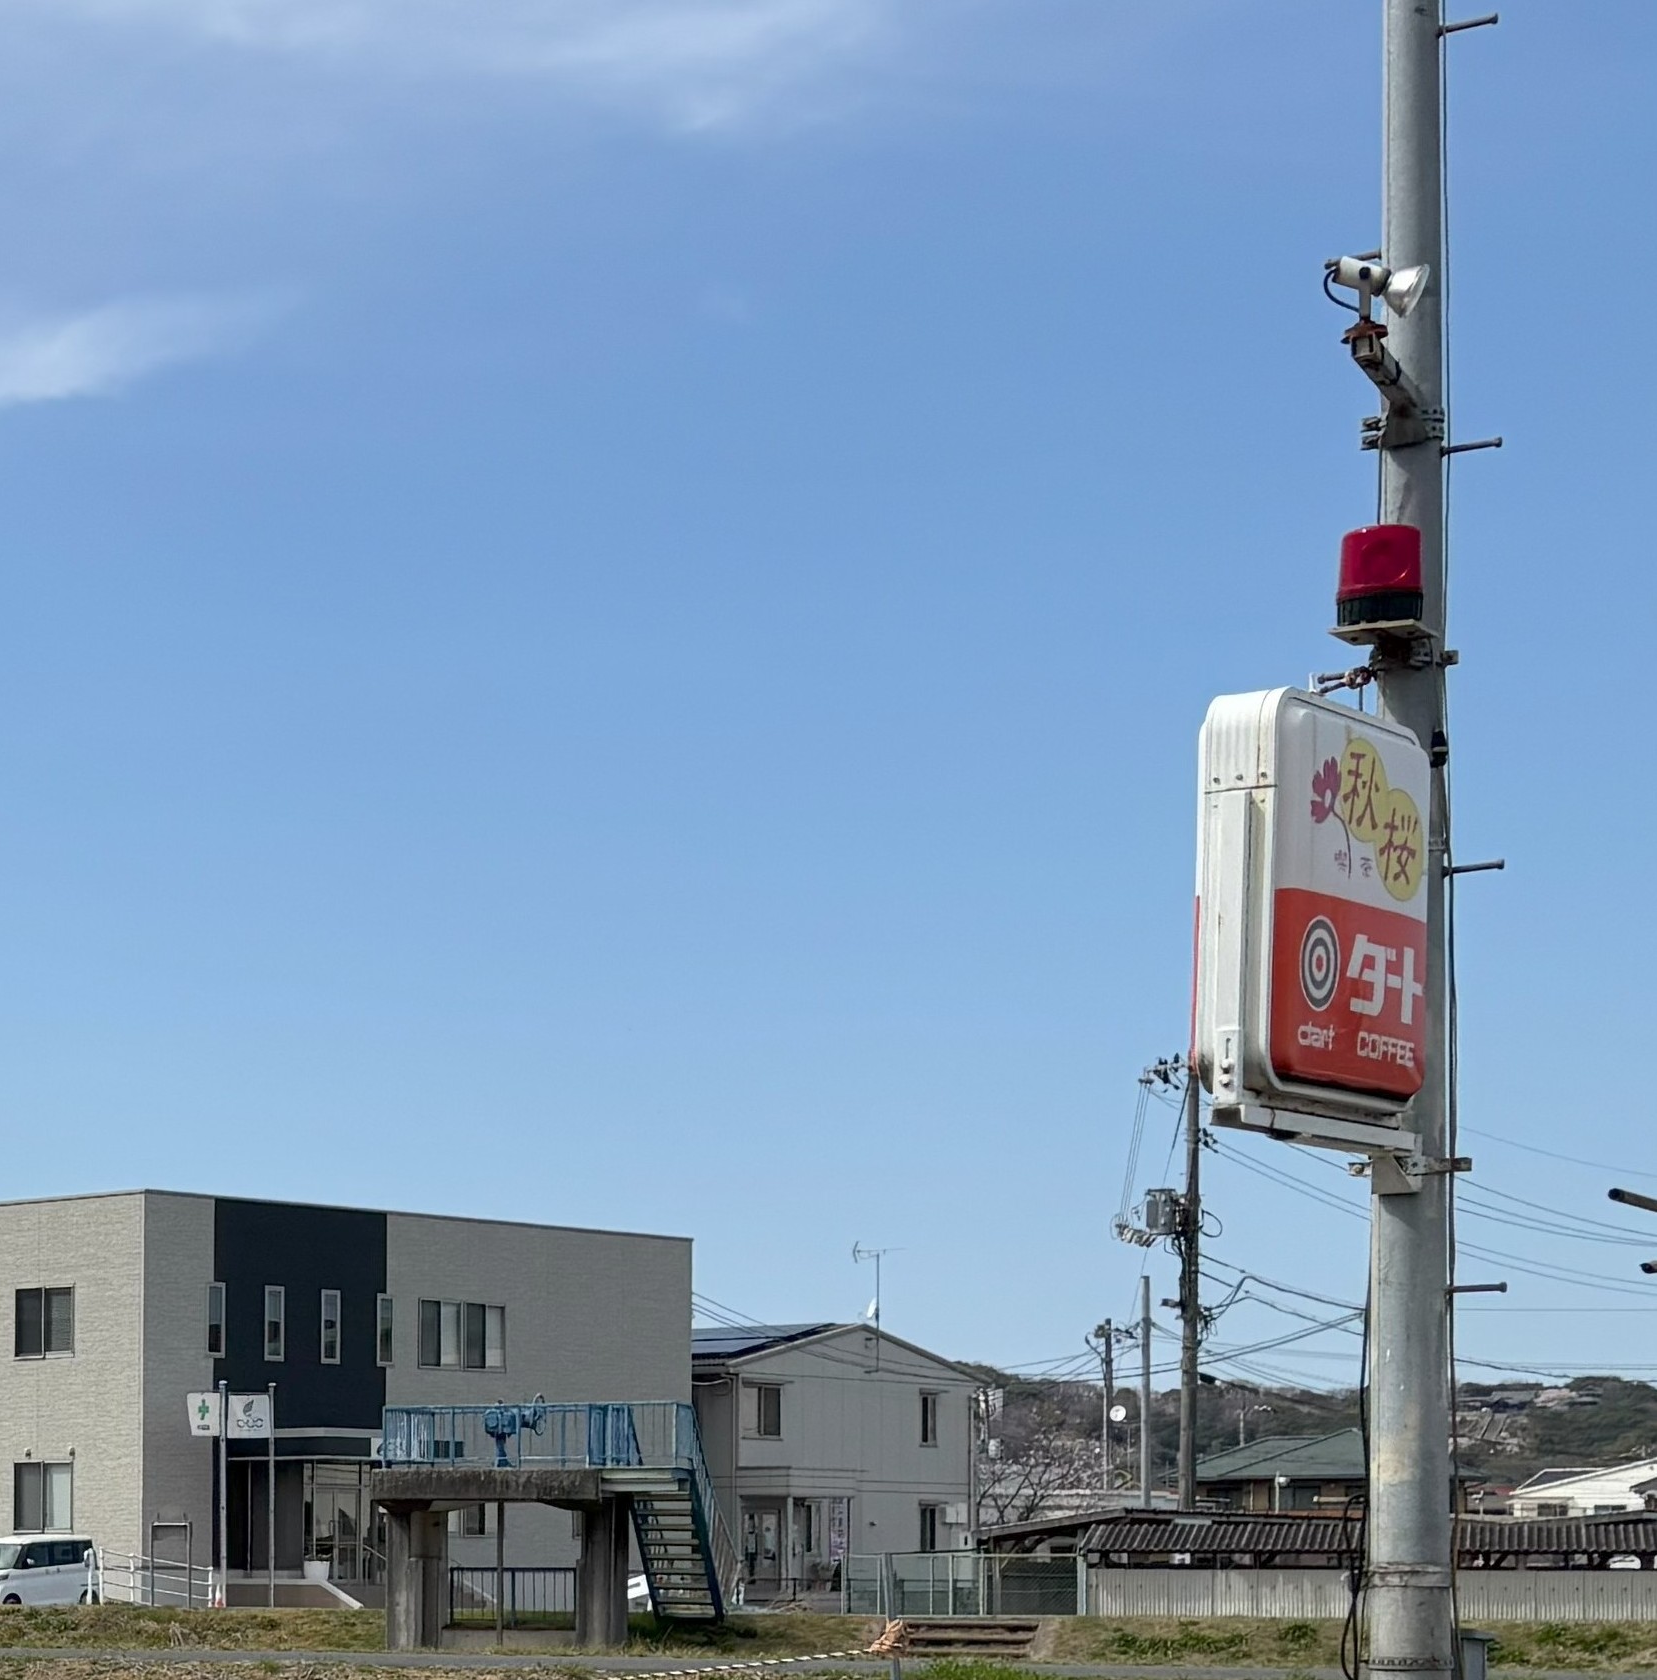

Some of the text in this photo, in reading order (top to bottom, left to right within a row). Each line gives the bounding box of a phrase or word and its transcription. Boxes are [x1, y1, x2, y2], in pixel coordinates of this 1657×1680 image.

[1342, 752, 1417, 886] 秋桜
[1346, 934, 1424, 1025] ダート
[1298, 1021, 1415, 1068] dart COFFEE
